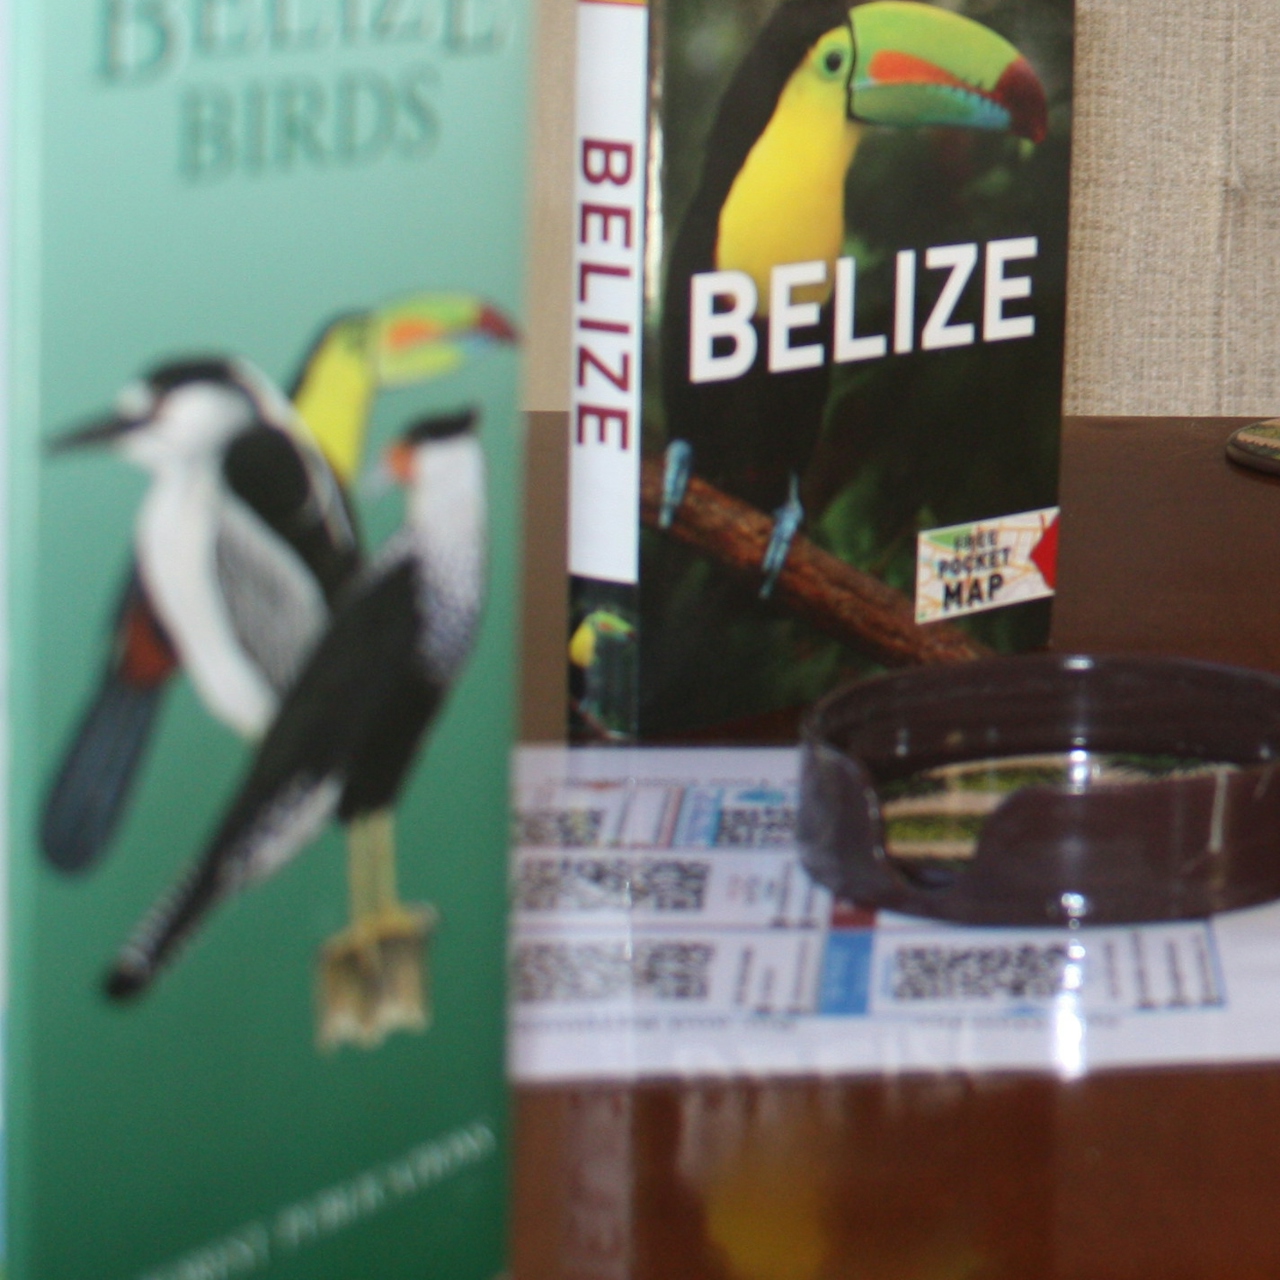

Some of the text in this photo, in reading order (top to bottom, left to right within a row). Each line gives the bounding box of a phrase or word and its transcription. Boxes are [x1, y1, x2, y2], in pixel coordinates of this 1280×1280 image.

[178, 67, 442, 182] BIRDS
[578, 140, 633, 451] BELIZE
[689, 236, 1039, 385] BELIZE
[939, 548, 1010, 577] POCKET
[954, 529, 998, 551] FREE
[943, 574, 1003, 609] MAP
